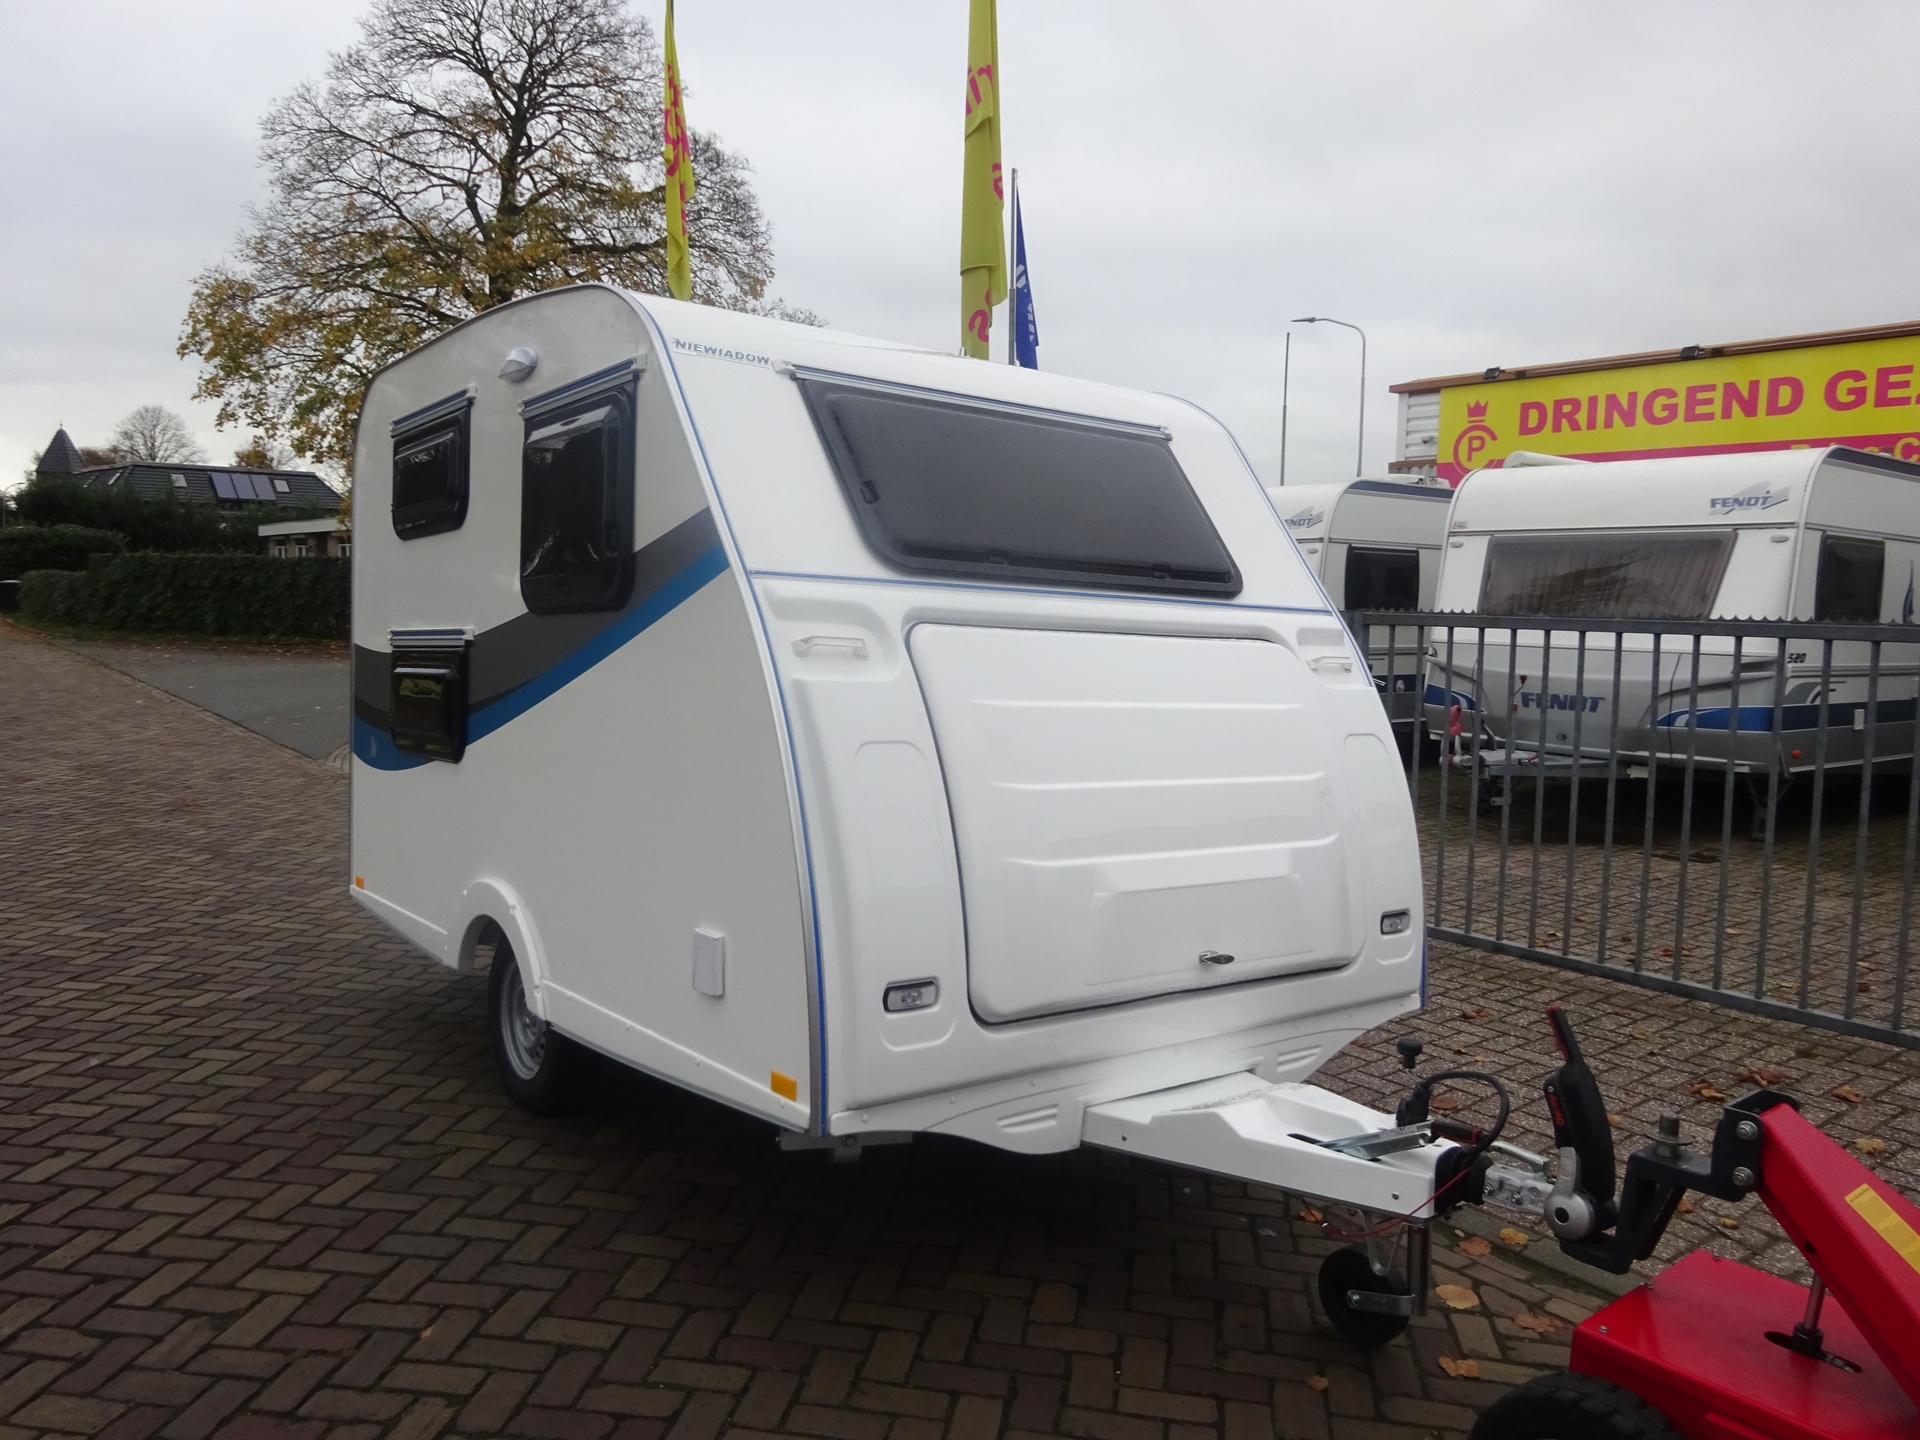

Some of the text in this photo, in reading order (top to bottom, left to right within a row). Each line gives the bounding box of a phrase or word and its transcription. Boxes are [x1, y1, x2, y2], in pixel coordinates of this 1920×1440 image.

[675, 339, 770, 365] NIEWIADOW
[1518, 364, 1920, 436] DRINGEND GE
[1710, 495, 1773, 508] FENDT
[1787, 653, 1806, 663] 520
